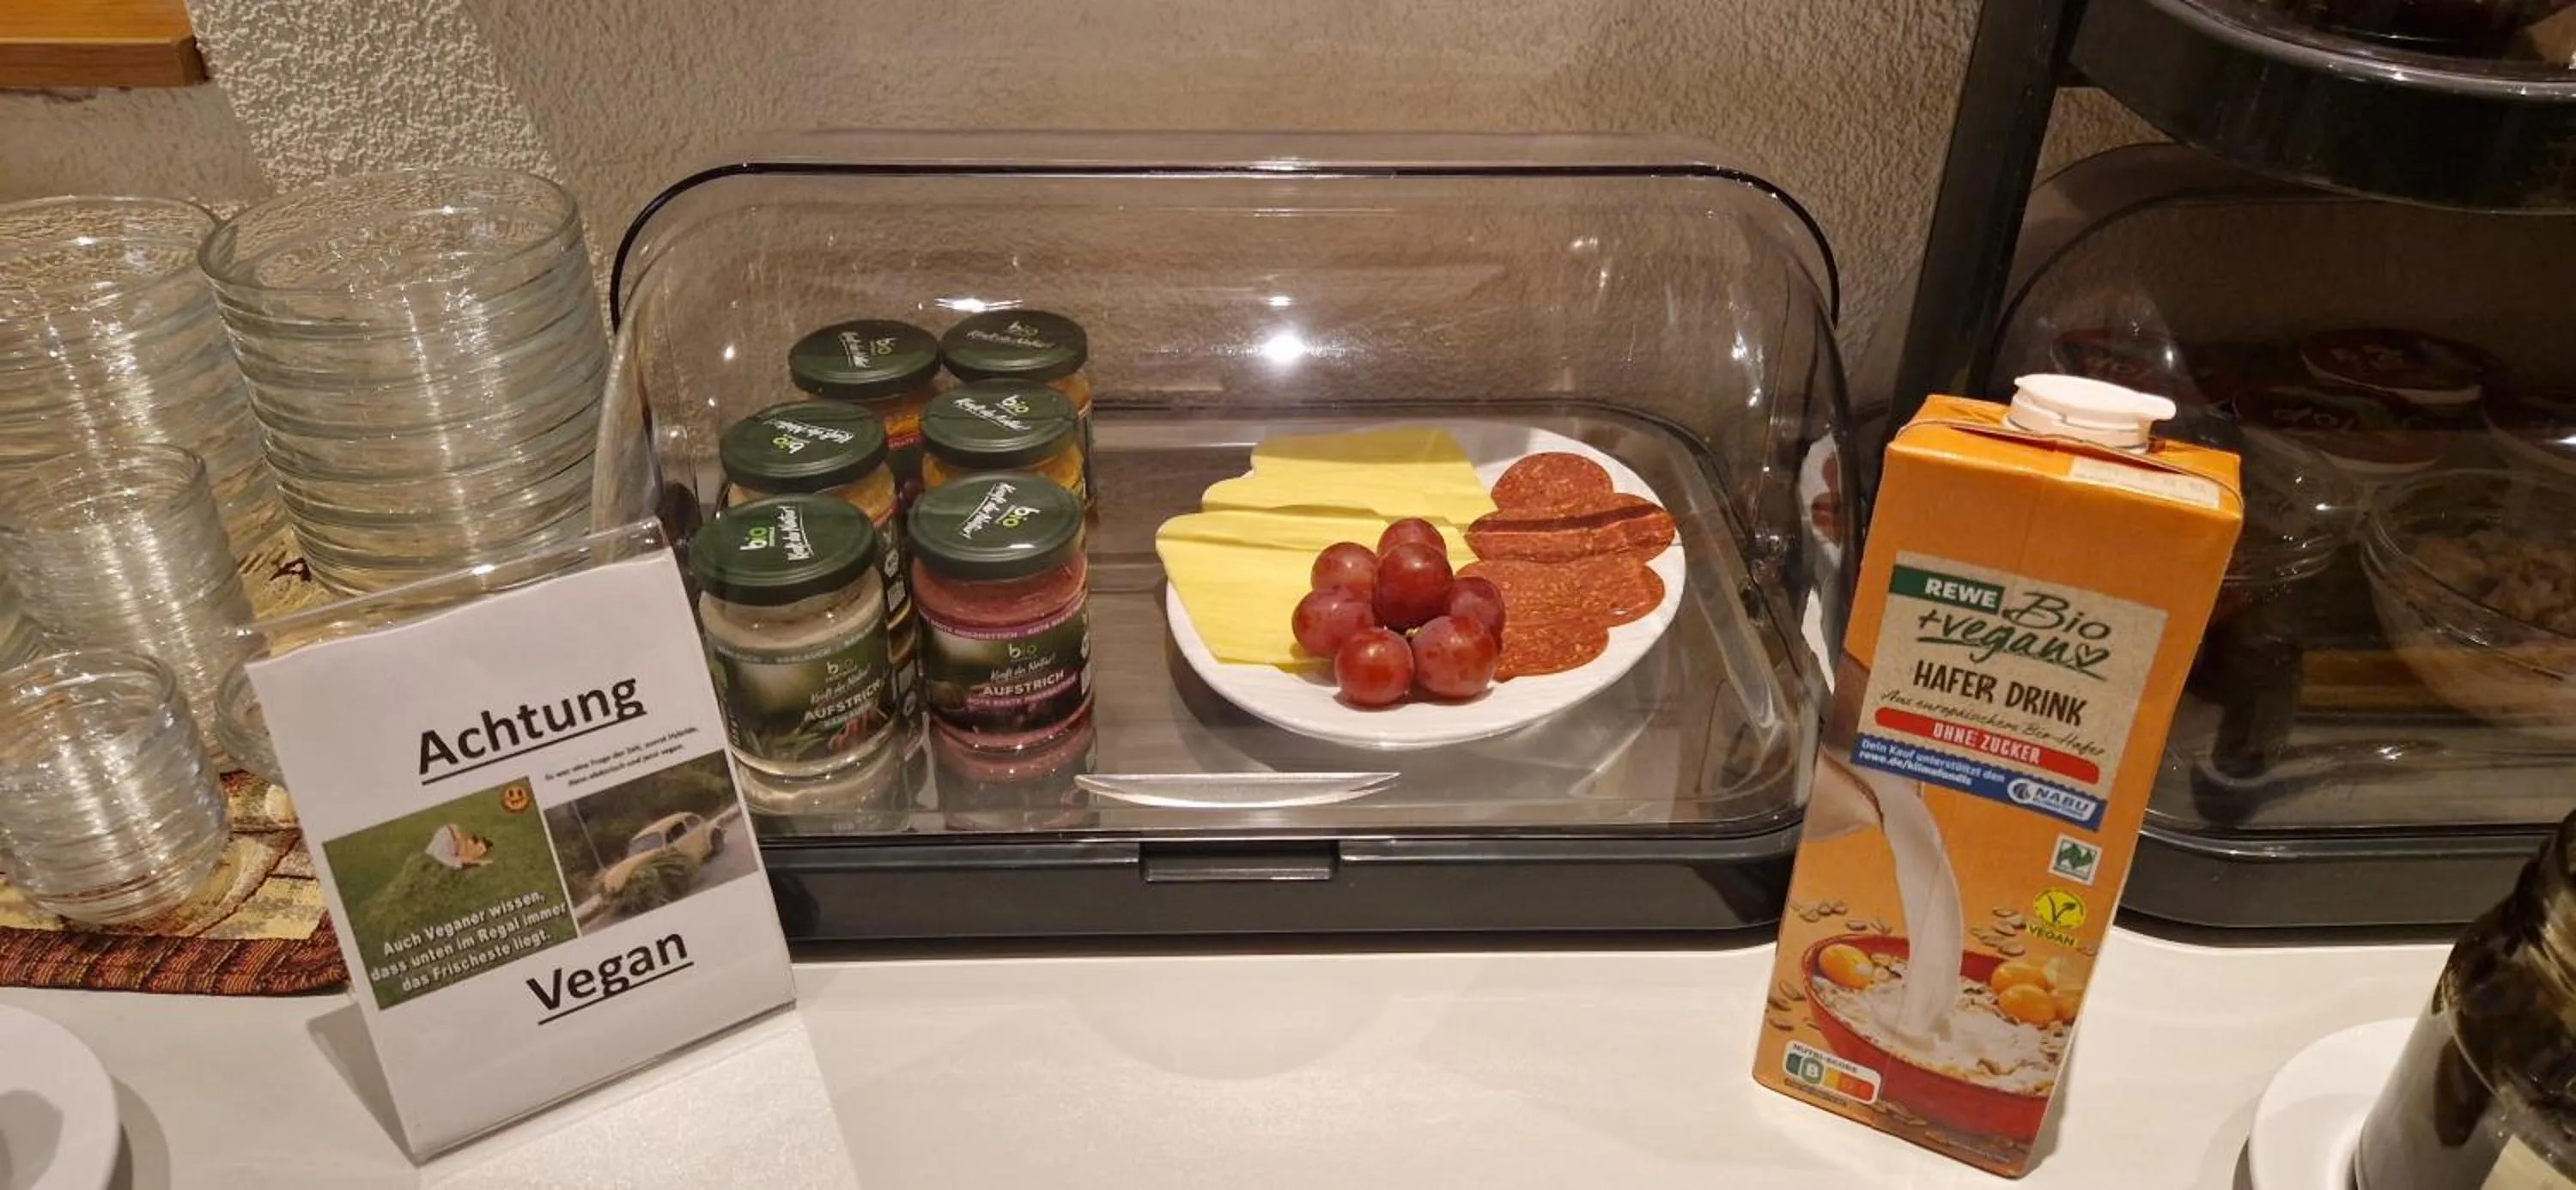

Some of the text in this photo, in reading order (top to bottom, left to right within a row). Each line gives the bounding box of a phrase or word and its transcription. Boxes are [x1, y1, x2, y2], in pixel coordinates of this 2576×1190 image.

[739, 526, 768, 550] bio
[1002, 507, 1041, 527] bio
[1924, 577, 2111, 641] REWE Bio
[1008, 642, 1037, 659] bio
[804, 678, 882, 721] AUFSTRICH
[983, 670, 1065, 696] AUFSTRICH
[1913, 659, 2087, 726] HAFER DRINK
[418, 678, 646, 775] Achtung
[1933, 722, 2041, 764] OHNE ZUCKER
[1862, 738, 1886, 753] Dein
[1889, 744, 1916, 760] Kauf
[2036, 787, 2089, 811] NABU
[371, 902, 567, 981] dass unten im Regal immer
[384, 932, 422, 956] Auch
[424, 910, 486, 940] Veganer
[2029, 924, 2075, 946] VEGAN
[402, 928, 550, 992] das Frischeste liegt.
[527, 932, 689, 1012] Vegan
[1794, 1043, 1857, 1072] NUTRI-SCORE
